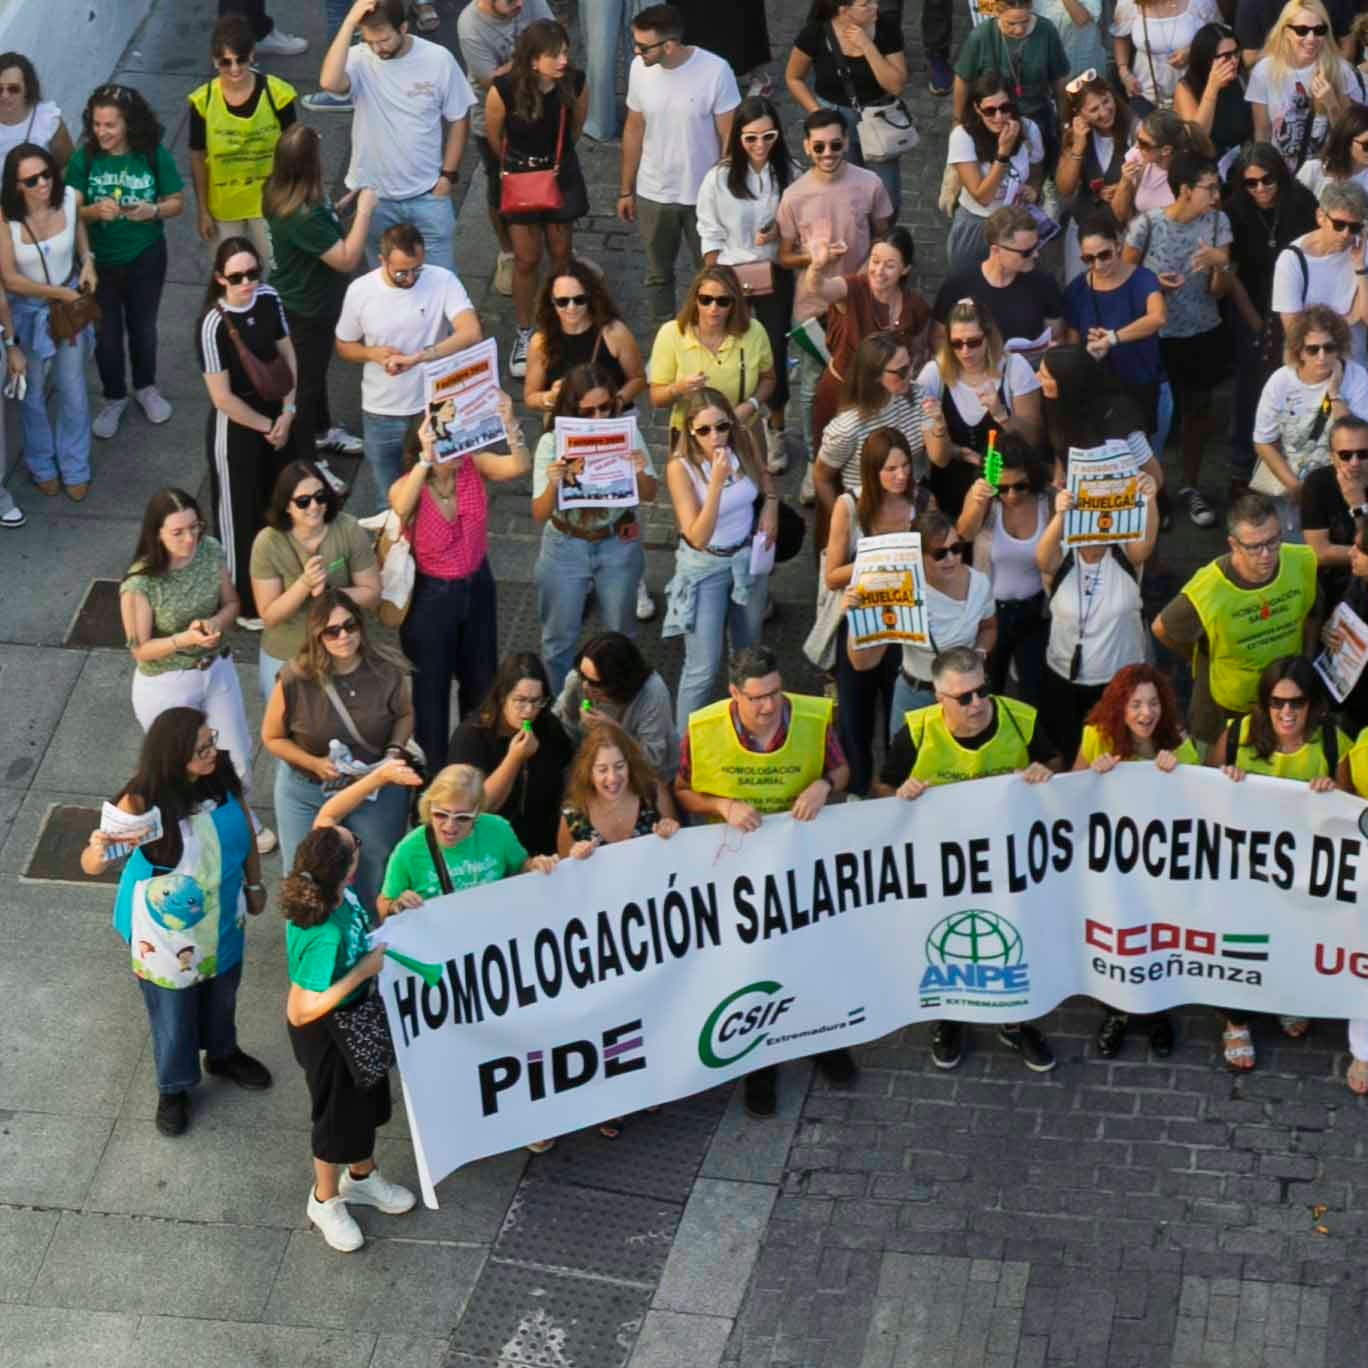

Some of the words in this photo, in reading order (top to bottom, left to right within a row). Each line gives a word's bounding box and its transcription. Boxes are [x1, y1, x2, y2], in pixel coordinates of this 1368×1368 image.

[394, 872, 722, 1047] HOMOLOGACIÓN
[734, 843, 928, 945] SALARIAL
[942, 837, 992, 897] DE
[1007, 817, 1073, 894] LOS
[1088, 811, 1295, 891] DOCENTES
[1309, 835, 1357, 904] DE
[1085, 918, 1216, 956] CCOO
[919, 964, 1029, 993] ANPE
[1092, 954, 1262, 987] enseñanza
[718, 995, 797, 1043] CSIF
[766, 1020, 848, 1047] Extremadura
